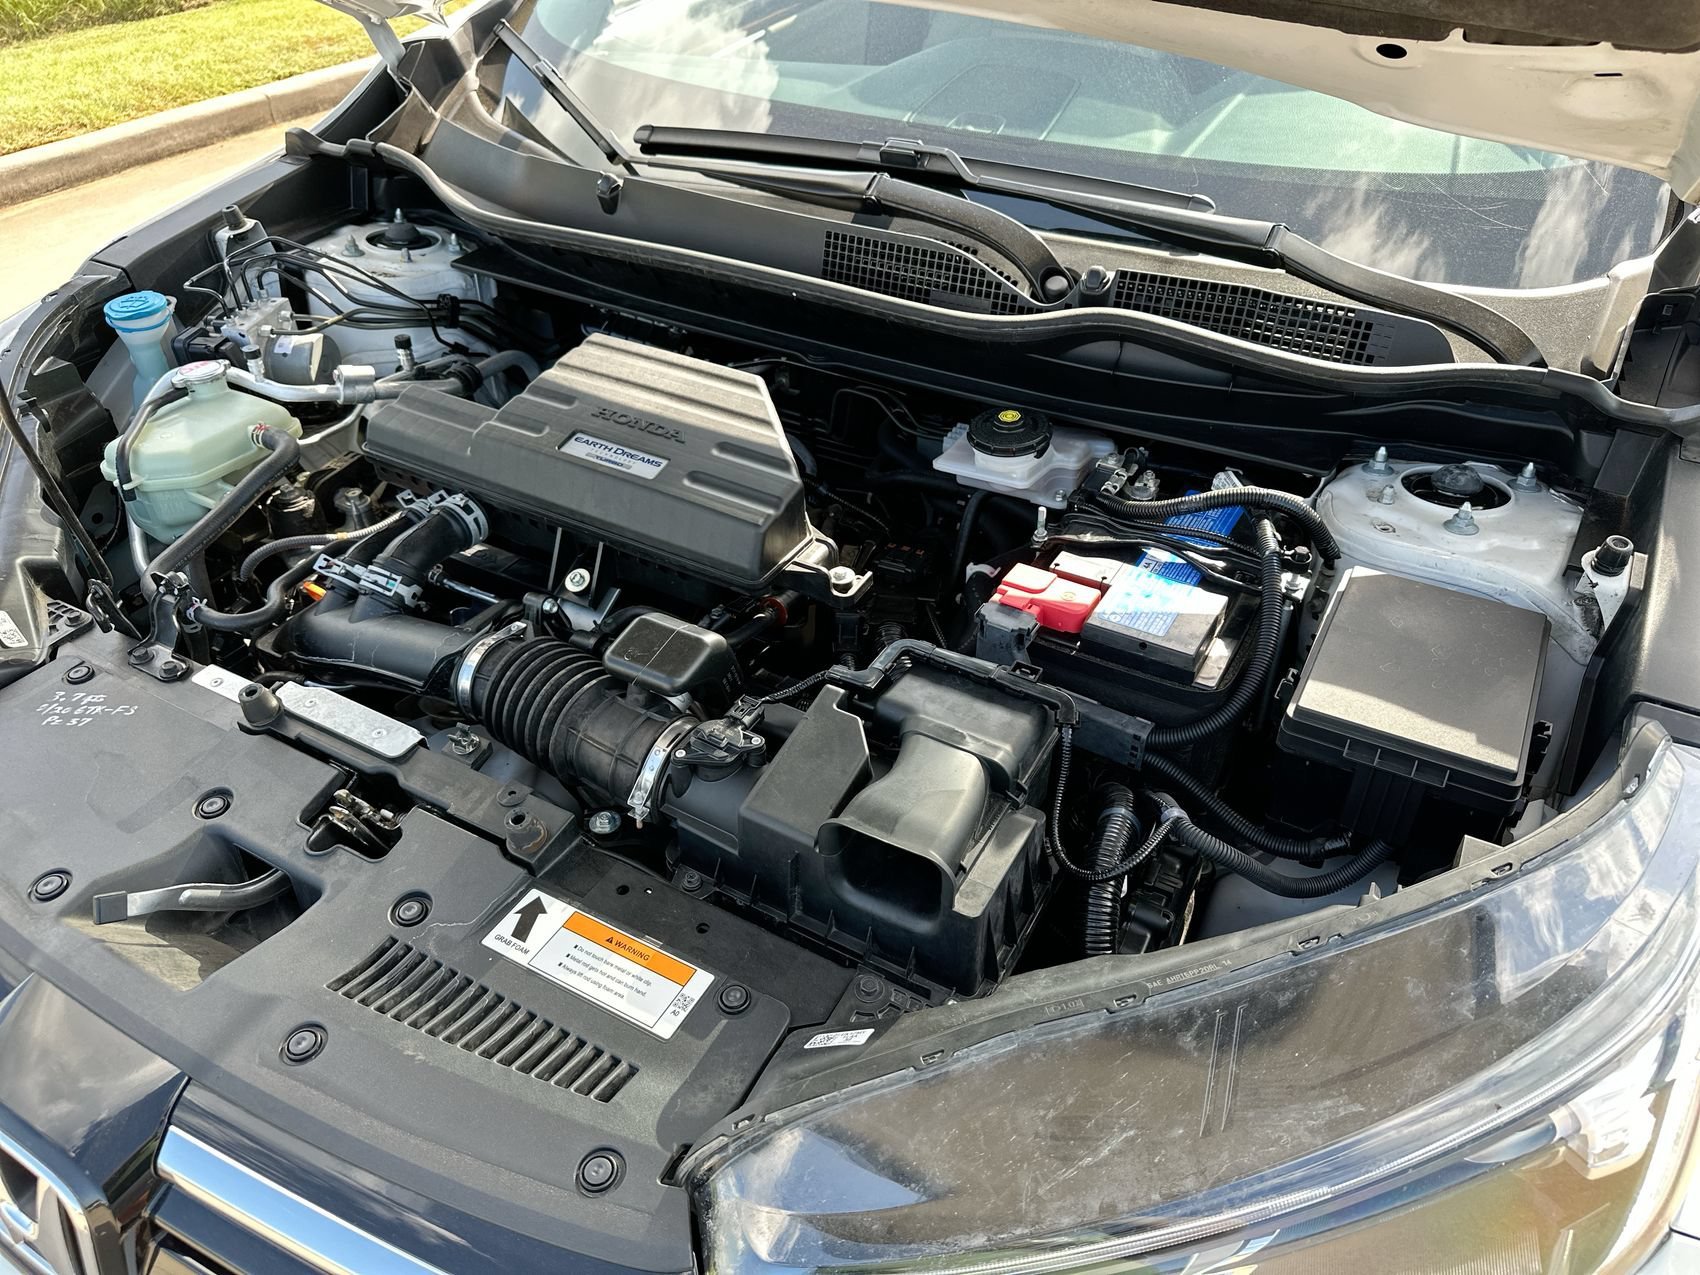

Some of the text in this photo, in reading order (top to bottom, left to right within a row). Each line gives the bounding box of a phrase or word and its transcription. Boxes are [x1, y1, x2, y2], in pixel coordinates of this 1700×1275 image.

[591, 408, 686, 445] HONDA
[574, 436, 613, 453] EARTH
[595, 455, 625, 468] TURBO
[494, 934, 530, 956] GRAB FOAM
[614, 939, 650, 961] WARNING
[570, 954, 583, 964] Metal
[588, 965, 599, 973] gets
[599, 969, 607, 977] hot
[577, 945, 585, 953] Do
[591, 953, 604, 962] touch
[603, 959, 614, 967] bare
[614, 965, 627, 974] metal
[631, 973, 644, 982] white
[562, 964, 578, 975] Always
[590, 980, 603, 989] using
[602, 984, 615, 994] foam
